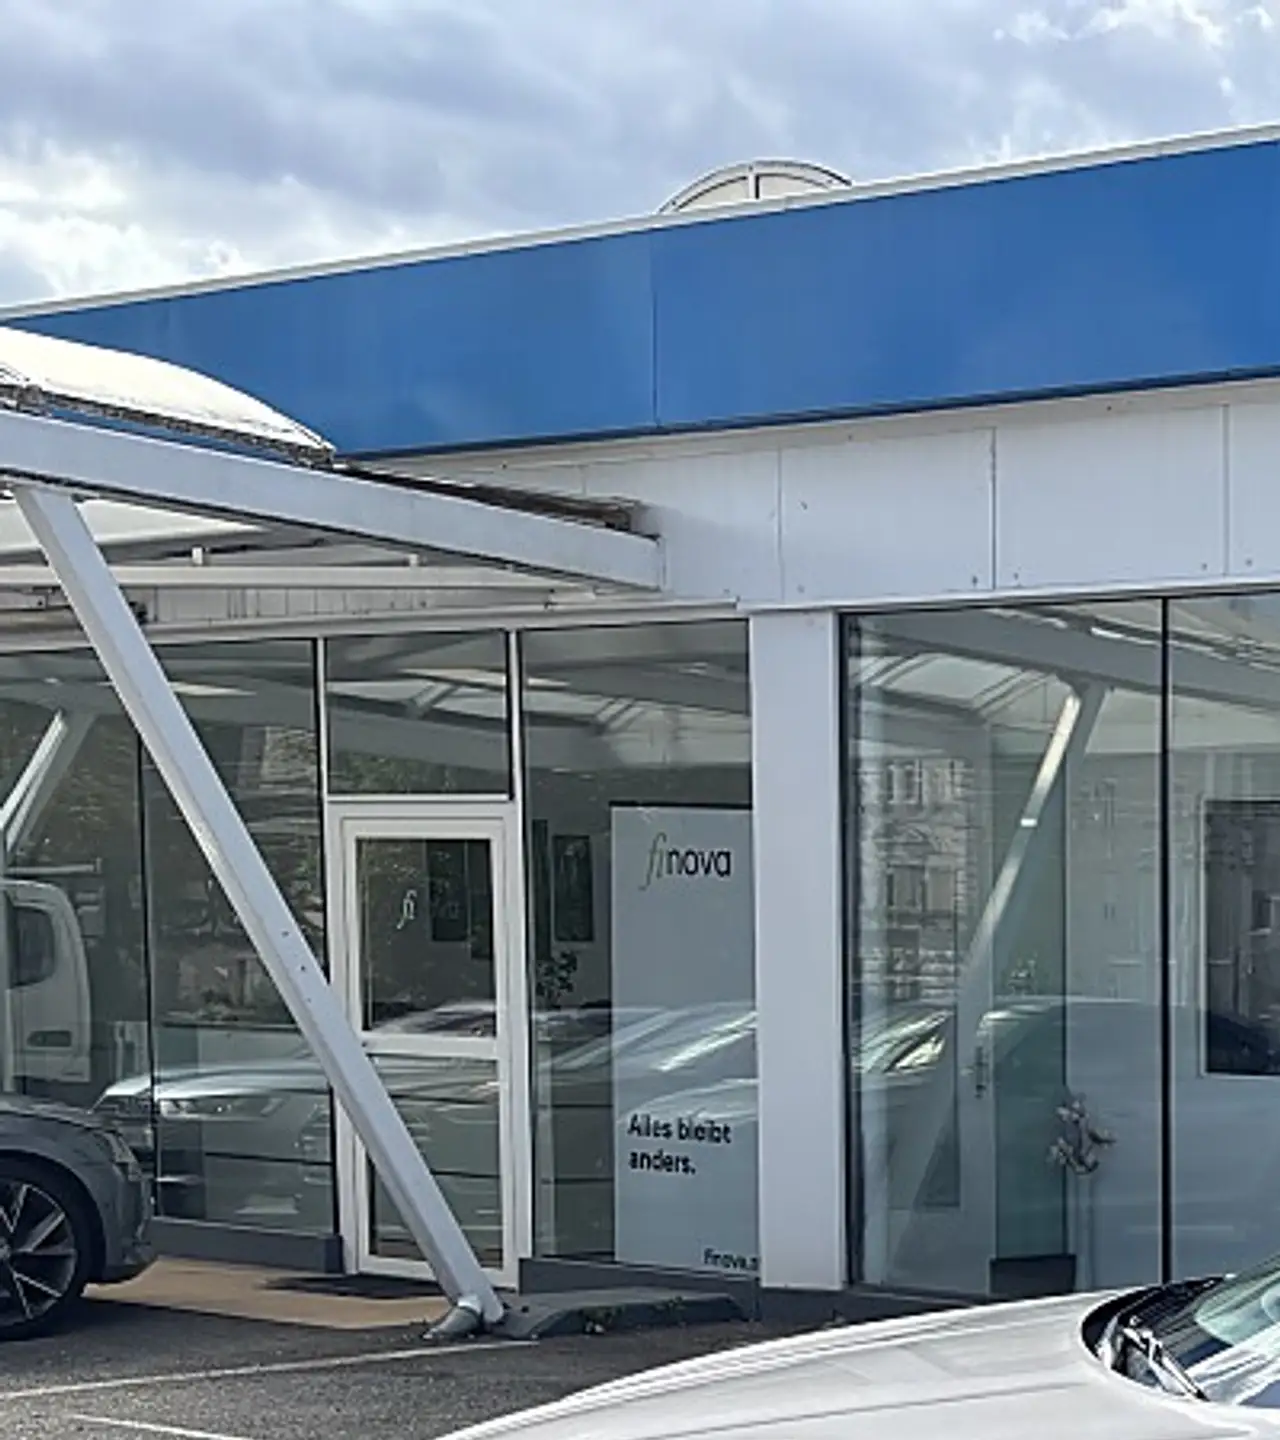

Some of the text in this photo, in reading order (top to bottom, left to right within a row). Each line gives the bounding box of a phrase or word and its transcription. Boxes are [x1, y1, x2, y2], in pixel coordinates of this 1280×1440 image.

[638, 832, 731, 892] finova
[628, 1113, 673, 1139] Alles
[629, 1149, 696, 1175] anders.
